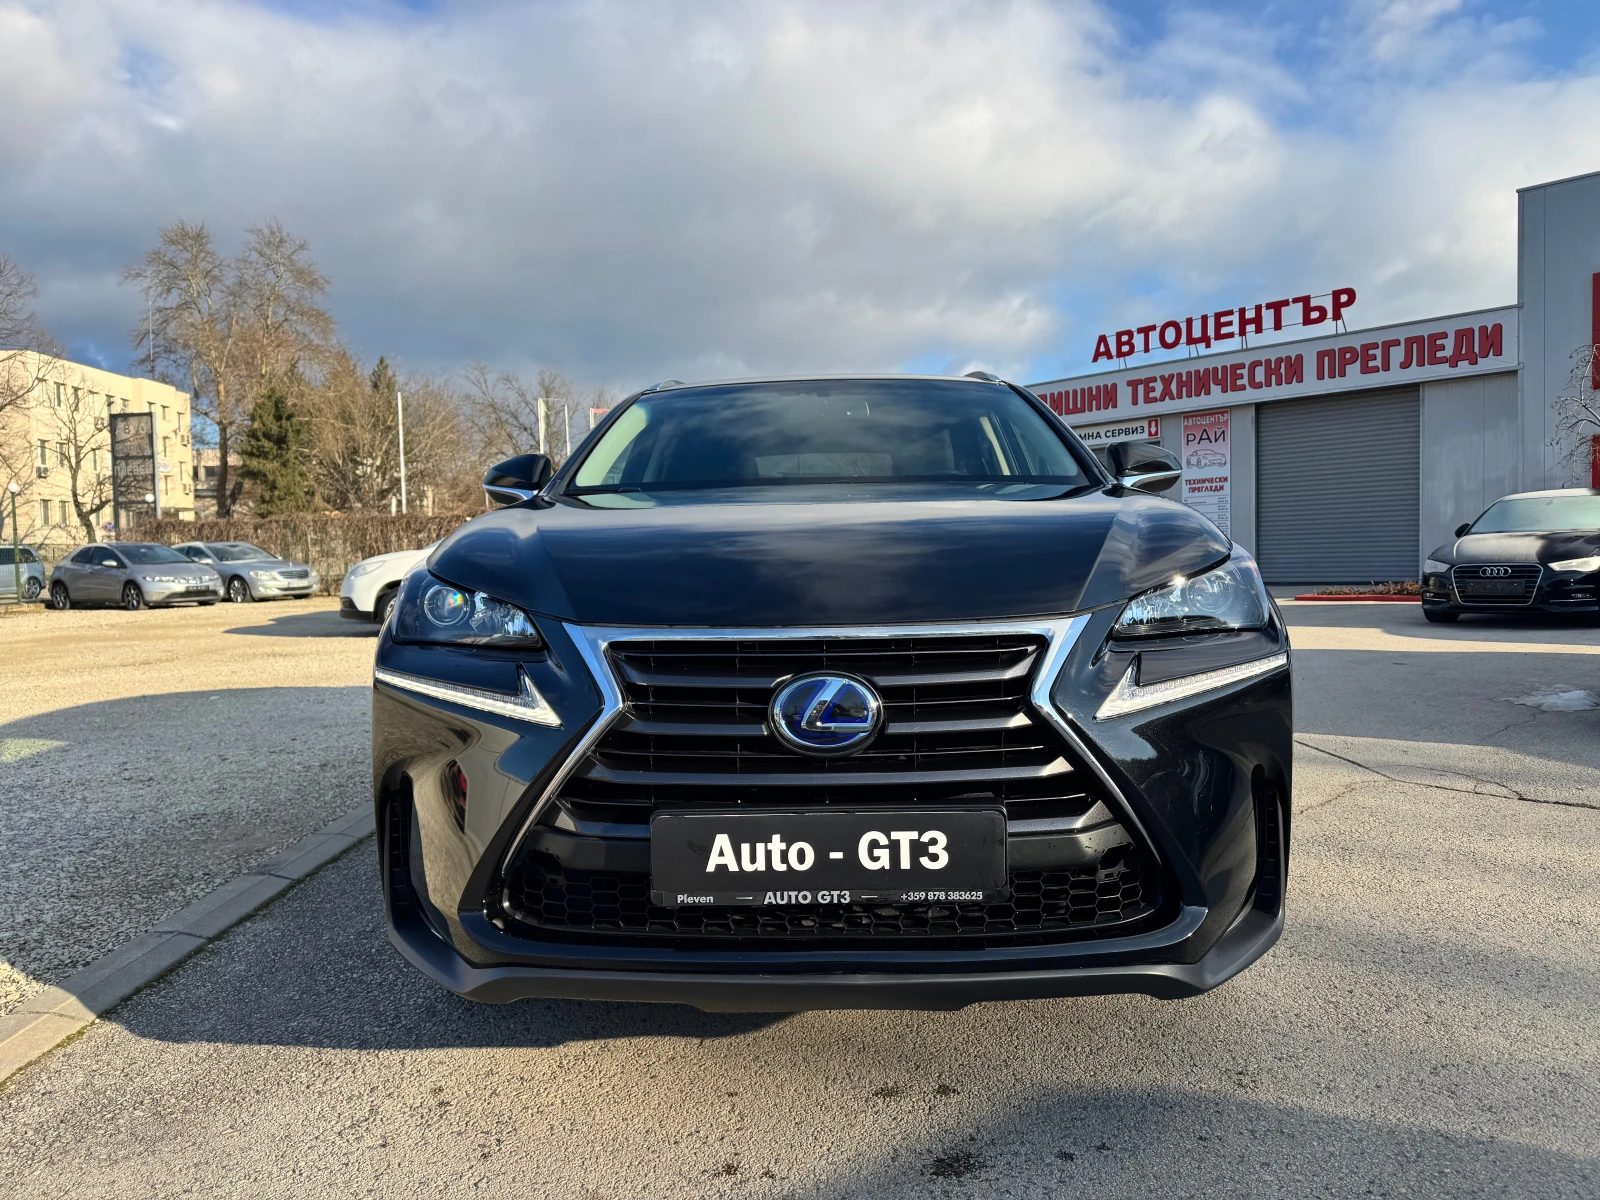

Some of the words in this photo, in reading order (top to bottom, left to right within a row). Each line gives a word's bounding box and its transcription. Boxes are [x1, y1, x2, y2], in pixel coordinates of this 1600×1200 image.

[1092, 287, 1357, 363] АВТОЦЕНТЪР
[1126, 353, 1304, 405] ТЕХНИЧЕСКИ
[1316, 323, 1503, 381] ПРЕГЛЕДИ
[1183, 413, 1229, 426] АВТОЦЕНТЪР
[1077, 431, 1102, 441] МНА
[1104, 425, 1145, 438] СЕРВИЗ
[1186, 426, 1226, 446] РАЙ
[1184, 476, 1229, 486] ТЕХНИЧЕСКИ
[1188, 484, 1225, 493] ПРЕГЛЕДИ
[706, 833, 815, 872] Auto
[858, 830, 949, 870] GT3
[676, 894, 714, 904] Pleven
[763, 891, 812, 905] AUTO
[817, 890, 851, 904] GT3
[900, 892, 925, 901] +359
[927, 891, 946, 900] 878
[947, 891, 983, 900] 383625
